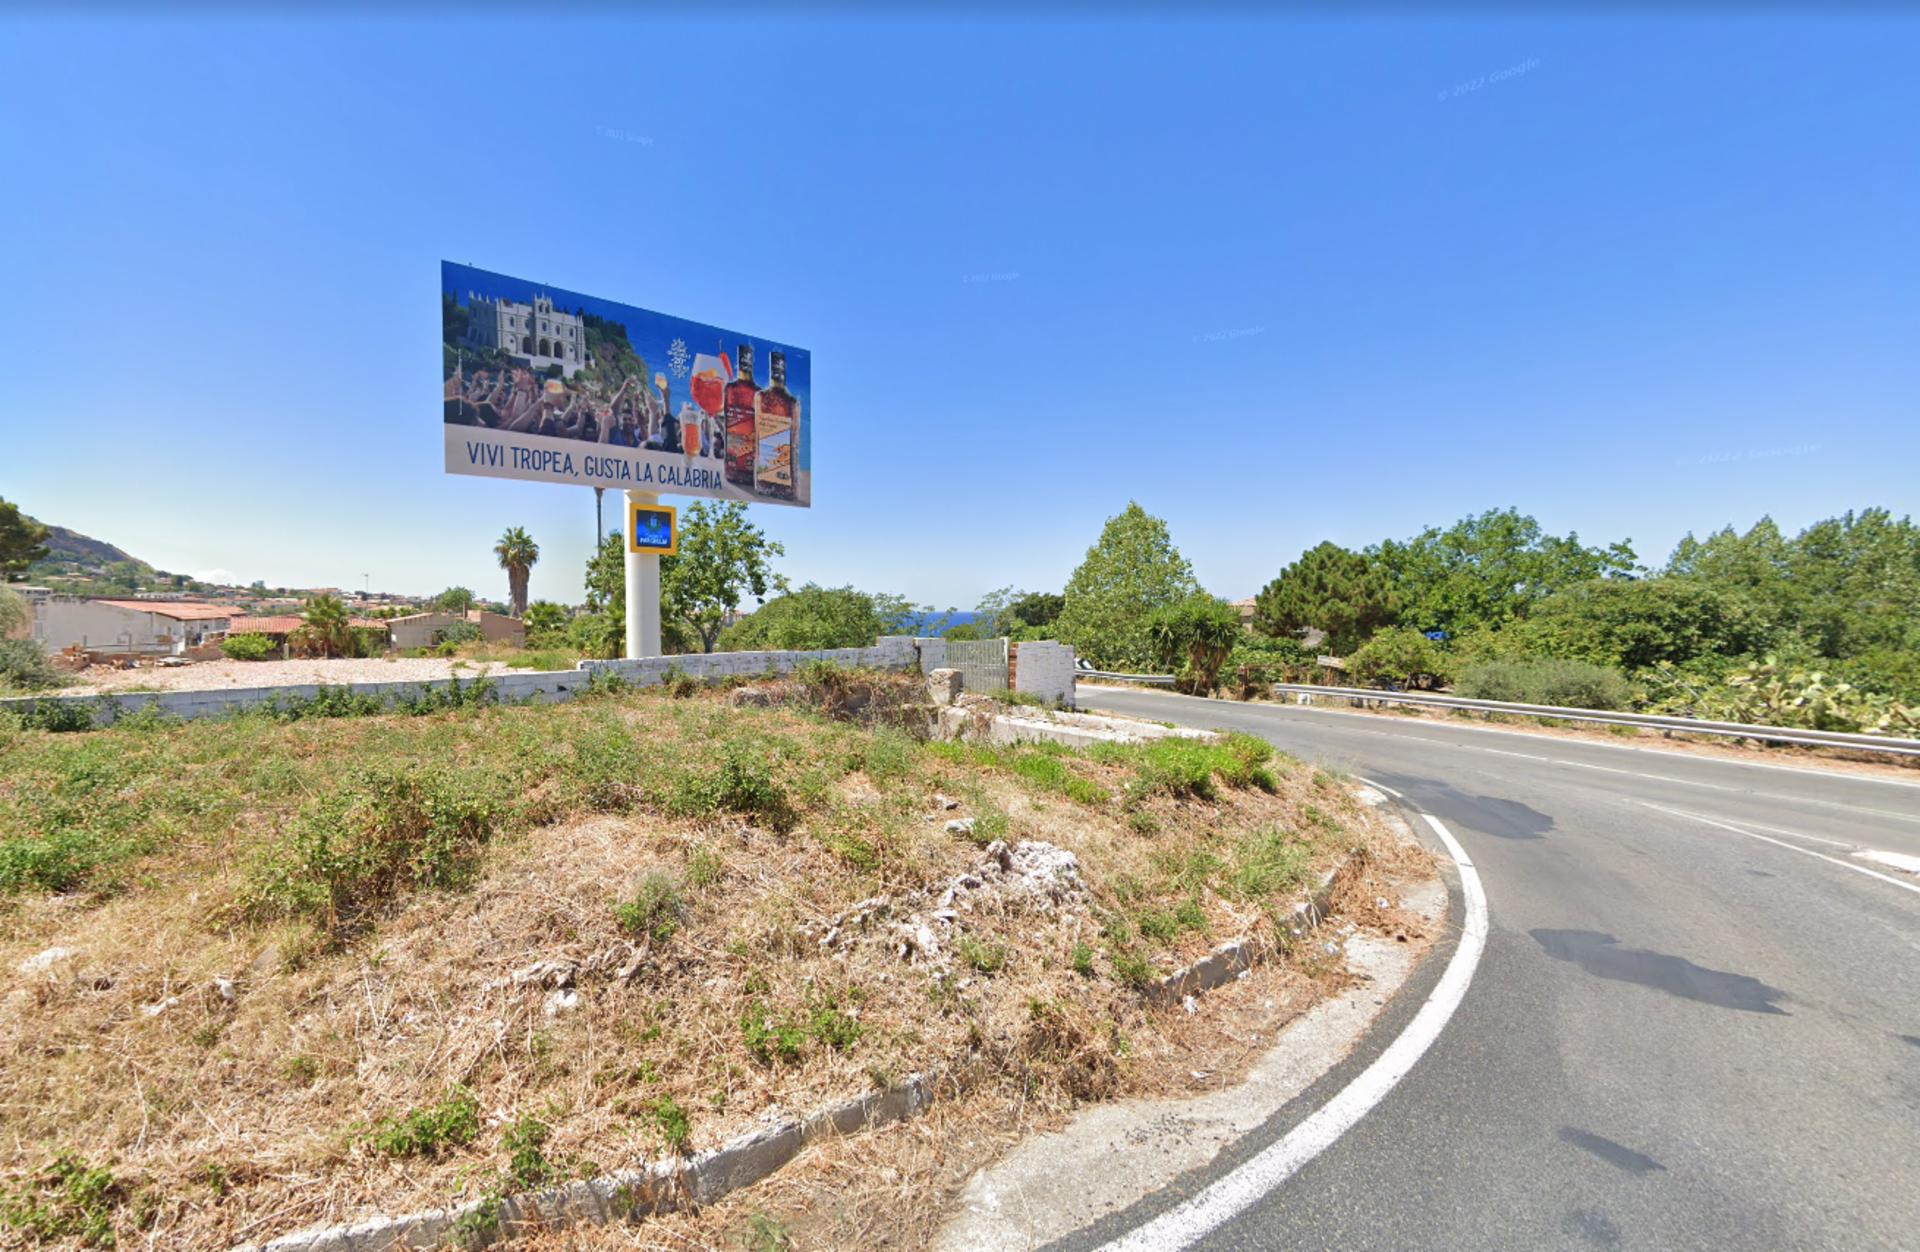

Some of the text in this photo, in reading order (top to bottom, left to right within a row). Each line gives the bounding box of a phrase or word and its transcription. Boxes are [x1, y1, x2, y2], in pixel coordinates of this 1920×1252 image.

[467, 441, 723, 490] VIVI TROPEA, GUSTA LA CALABRIA
